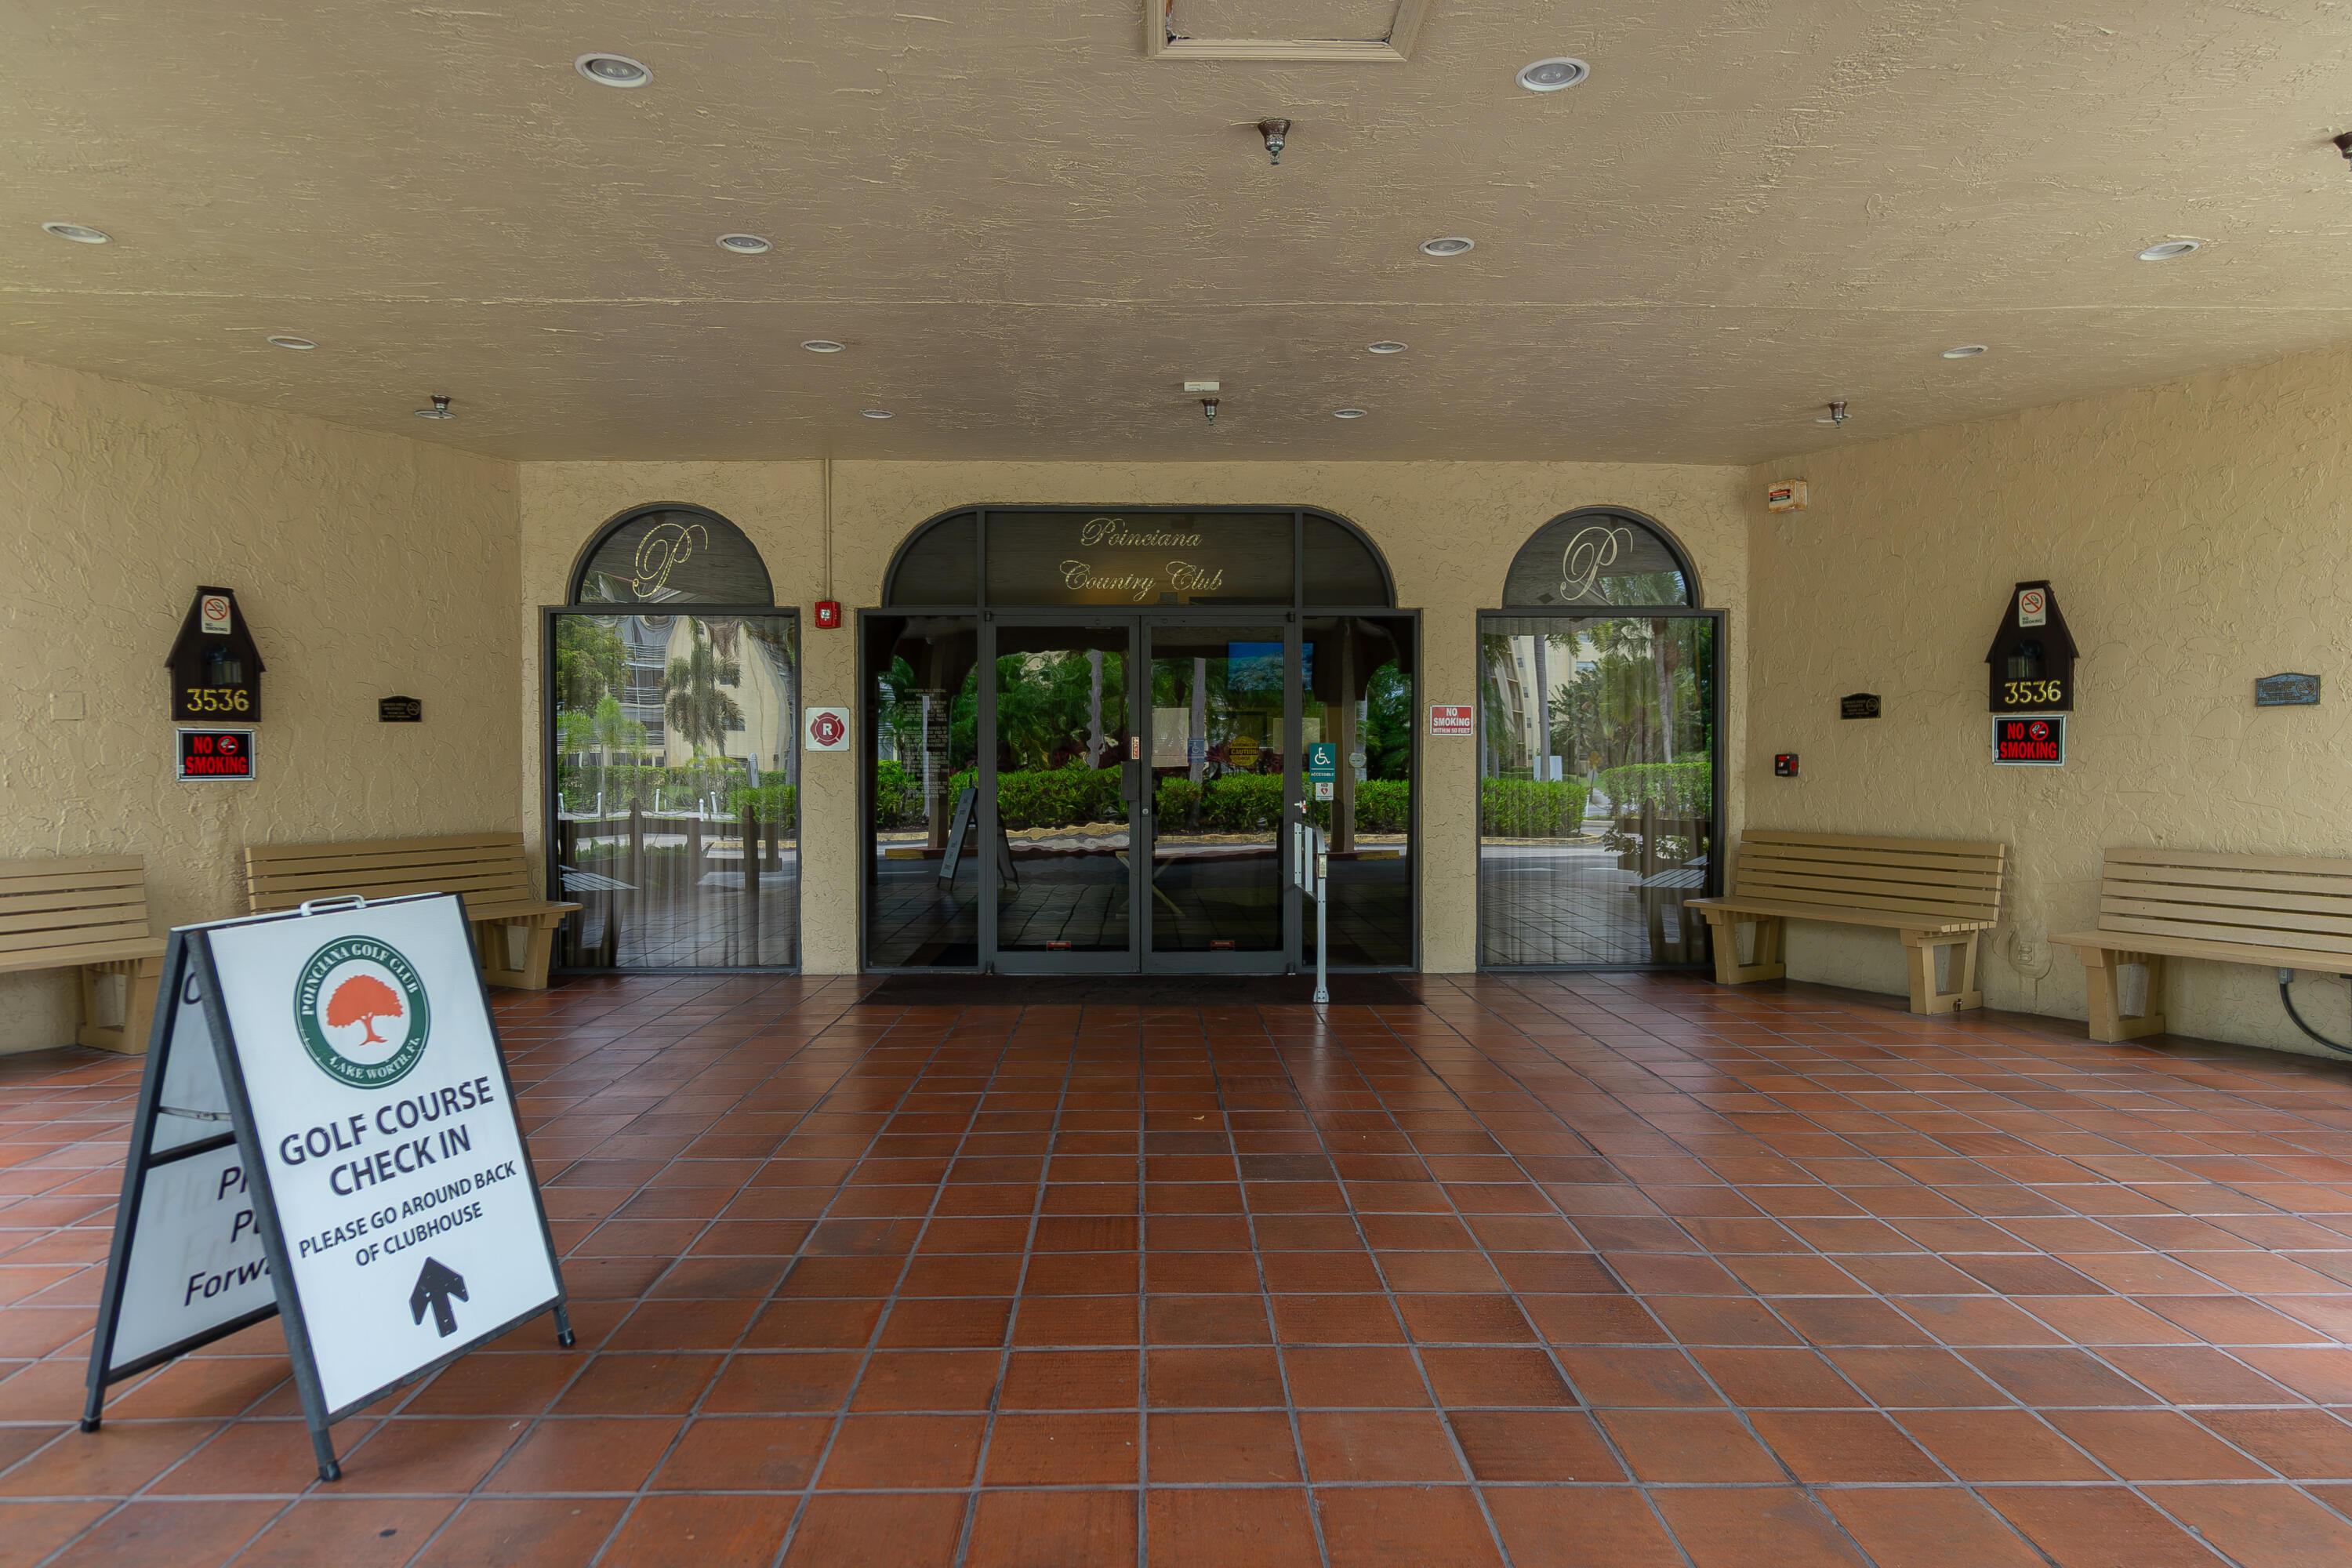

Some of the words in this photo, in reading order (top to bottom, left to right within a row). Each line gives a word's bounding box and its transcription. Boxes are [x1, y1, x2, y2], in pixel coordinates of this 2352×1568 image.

[1080, 517, 1203, 546] Poinciana
[1059, 560, 1156, 602] Country
[1165, 561, 1223, 590] Club
[187, 688, 250, 712] 3536
[2004, 680, 2062, 705] 3536
[1433, 717, 1471, 727] SMOKING
[1446, 707, 1458, 717] NO
[822, 723, 833, 735] R
[2007, 723, 2024, 739] NO
[193, 736, 213, 754] NO
[2000, 741, 2058, 760] SMOKING
[185, 756, 249, 775] SMOKING
[302, 946, 350, 1015] POINCIANA
[351, 943, 389, 962] GOLF
[390, 958, 419, 993] CLUB
[330, 1056, 365, 1079] LAKE
[280, 1112, 368, 1167] GOLF
[376, 1076, 495, 1135] COURSE
[329, 1136, 437, 1196] CHECK
[438, 1124, 472, 1160] IN
[298, 1217, 369, 1258] PLEASE
[370, 1207, 397, 1230] GO
[401, 1178, 472, 1218] AROUND
[474, 1160, 517, 1190] BACK
[355, 1243, 380, 1267] OF
[383, 1201, 484, 1255] CLUBHOUSE
